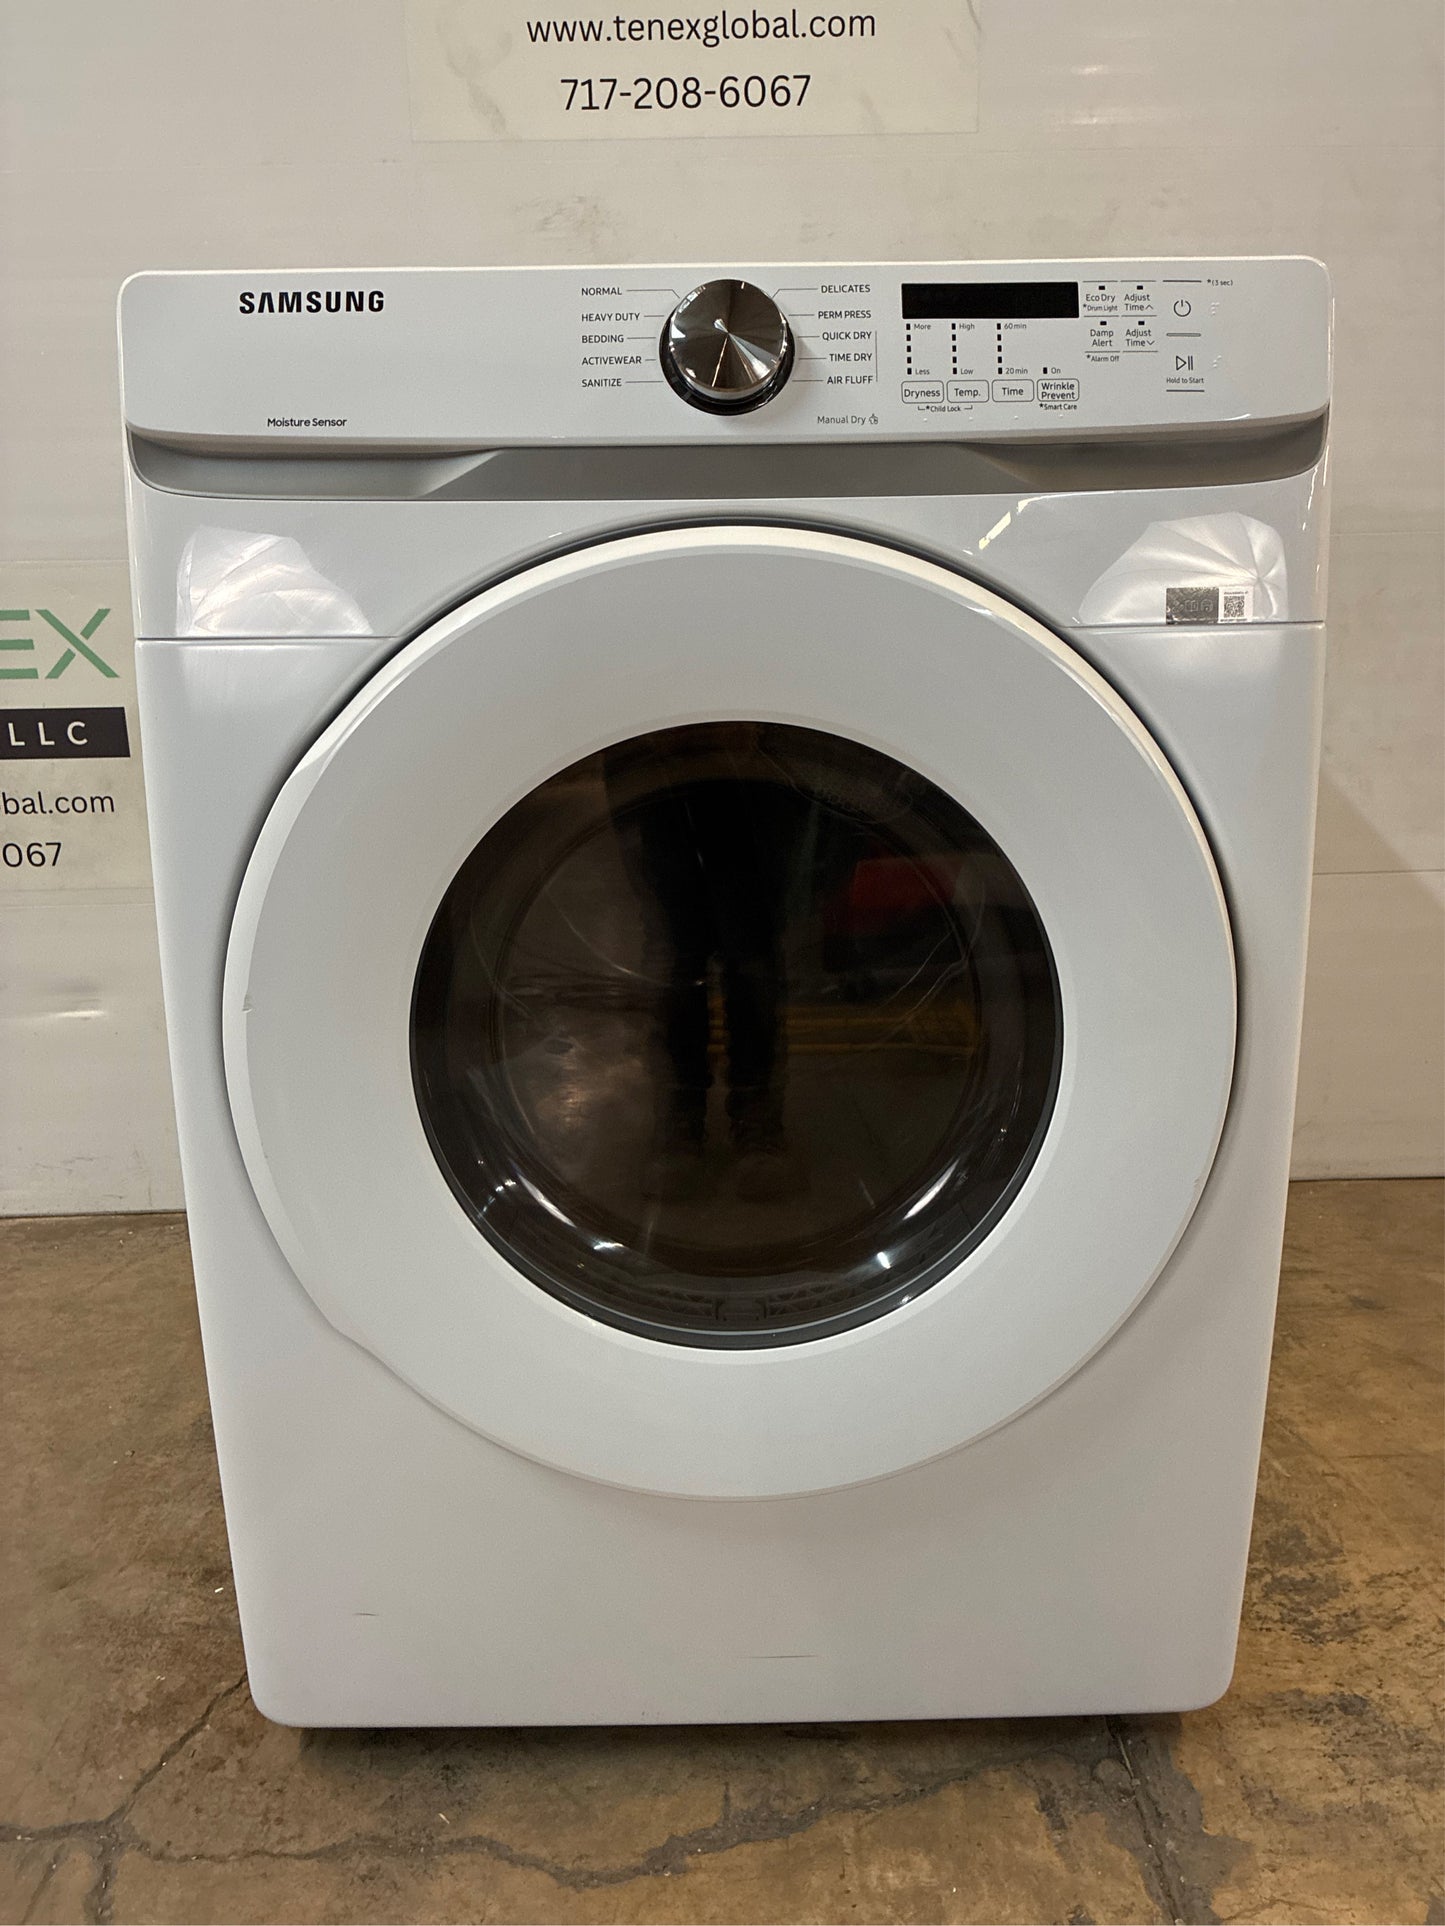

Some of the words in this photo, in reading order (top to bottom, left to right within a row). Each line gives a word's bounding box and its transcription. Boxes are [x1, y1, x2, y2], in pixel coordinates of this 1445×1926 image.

[527, 9, 876, 47] www.tenexglobal.com
[560, 74, 812, 111] 717-208-6067
[581, 287, 622, 296] NORMAL
[821, 284, 871, 293] DELICATES
[1101, 293, 1115, 302] Dry
[1124, 293, 1150, 302] Adjust
[239, 291, 384, 314] SAMSUNG
[581, 313, 613, 322] HEAVY
[615, 312, 640, 322] DUTY
[818, 310, 842, 319] PERM
[844, 310, 871, 319] PRESS
[959, 323, 975, 331] High
[822, 331, 850, 341] QUICK
[852, 331, 872, 340] DRY
[1090, 329, 1114, 339] Damp
[1126, 329, 1151, 338] Adjust
[581, 335, 624, 344] BEDDING
[1092, 339, 1112, 347] Alert
[581, 356, 642, 365] ACTIVEWEAR
[829, 353, 851, 362] TIME
[852, 353, 872, 362] DRY
[581, 378, 622, 387] SANITIZE
[827, 376, 842, 384] AIR
[843, 375, 873, 384] FLUFF
[1041, 382, 1075, 391] Wrinkle
[904, 389, 940, 399] Dryness
[954, 388, 981, 398] Temp.
[1002, 387, 1024, 396] Time
[1041, 391, 1075, 400] Prevent
[267, 417, 311, 427] Moisture
[312, 418, 347, 427] Sensor
[817, 415, 848, 425] Manual
[851, 415, 866, 426] Dry
[8, 721, 88, 746] LLC
[0, 791, 115, 815] bal.com
